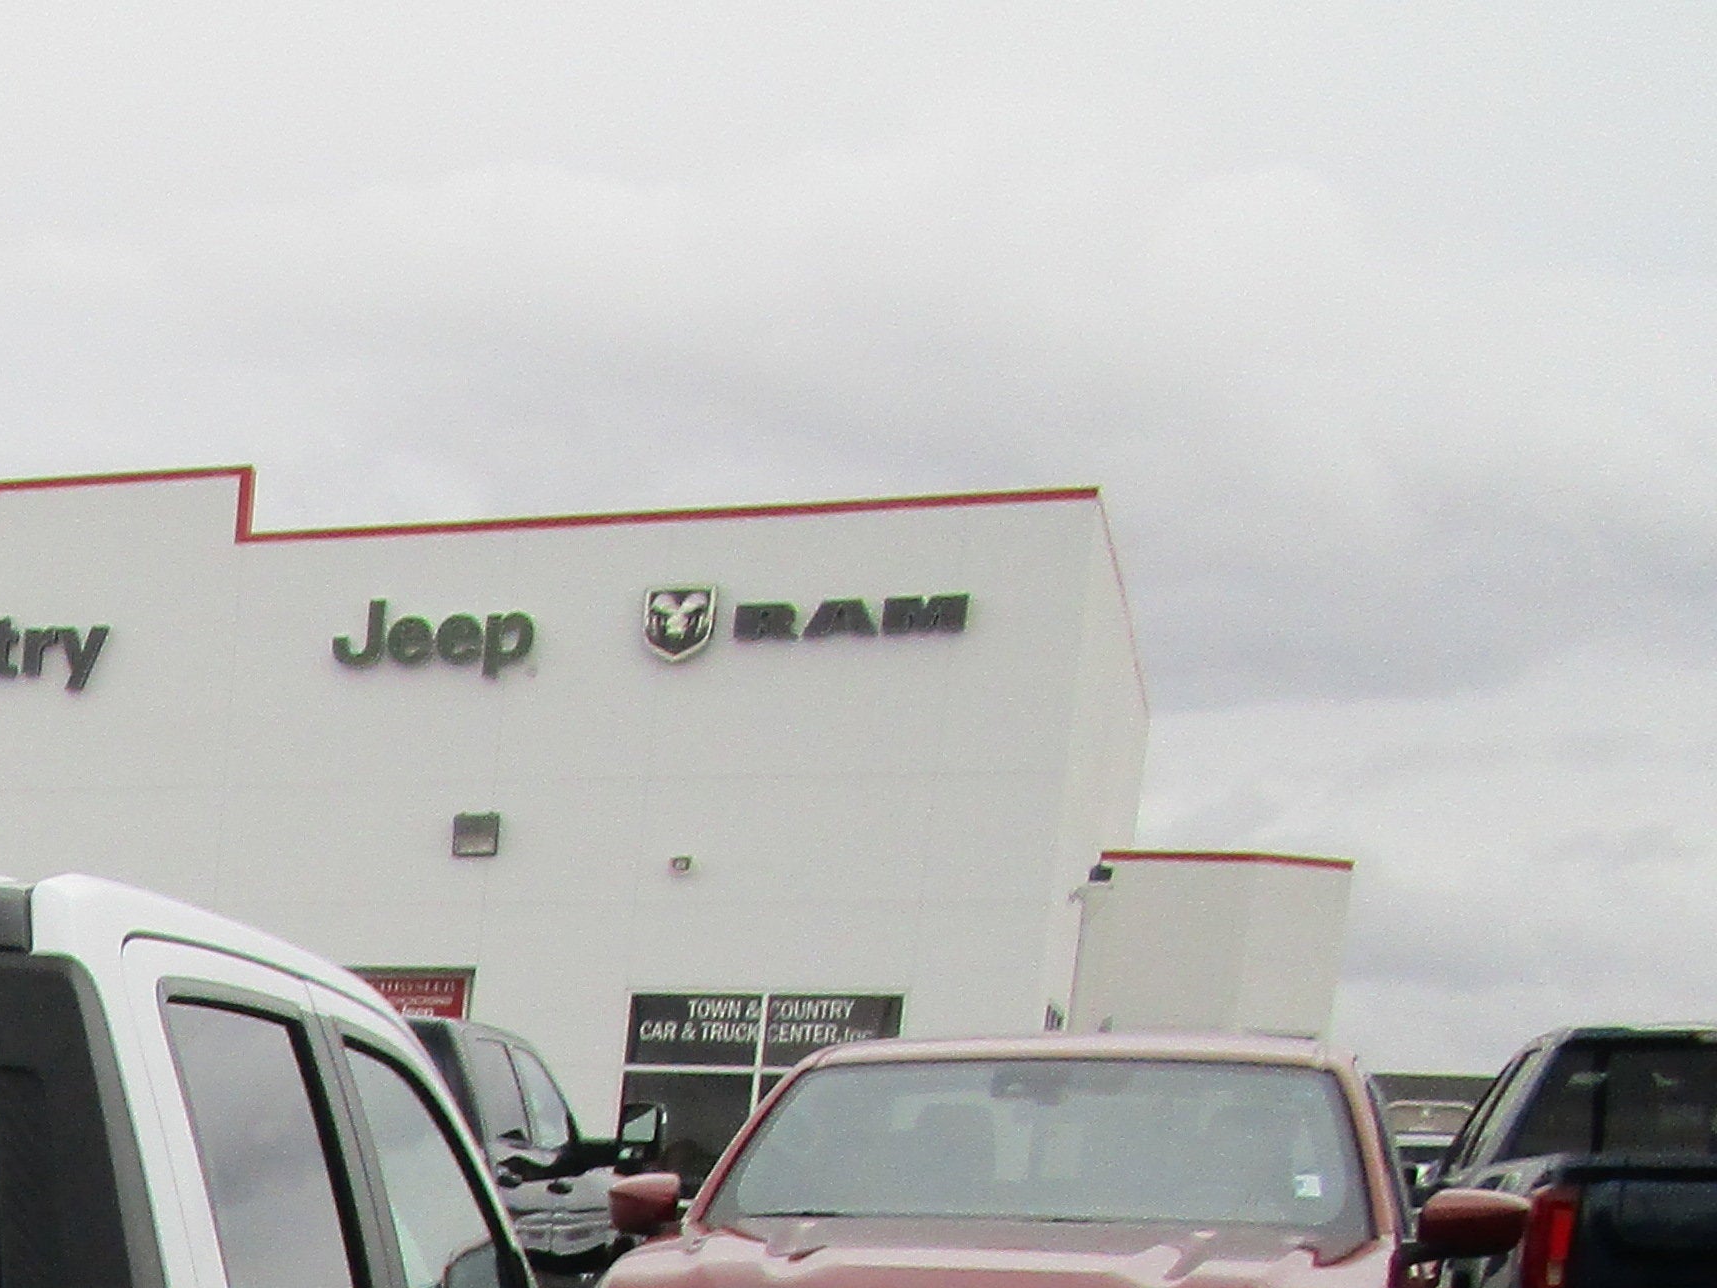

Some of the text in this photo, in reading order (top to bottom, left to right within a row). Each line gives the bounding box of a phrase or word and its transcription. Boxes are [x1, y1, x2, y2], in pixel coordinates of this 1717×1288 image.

[732, 592, 971, 641] RAM
[332, 597, 535, 680] Jeep
[686, 999, 855, 1021] TOWN & COUNTRY
[639, 1020, 676, 1042] CAR
[680, 1021, 697, 1042] &
[701, 1021, 762, 1044] TRUCK
